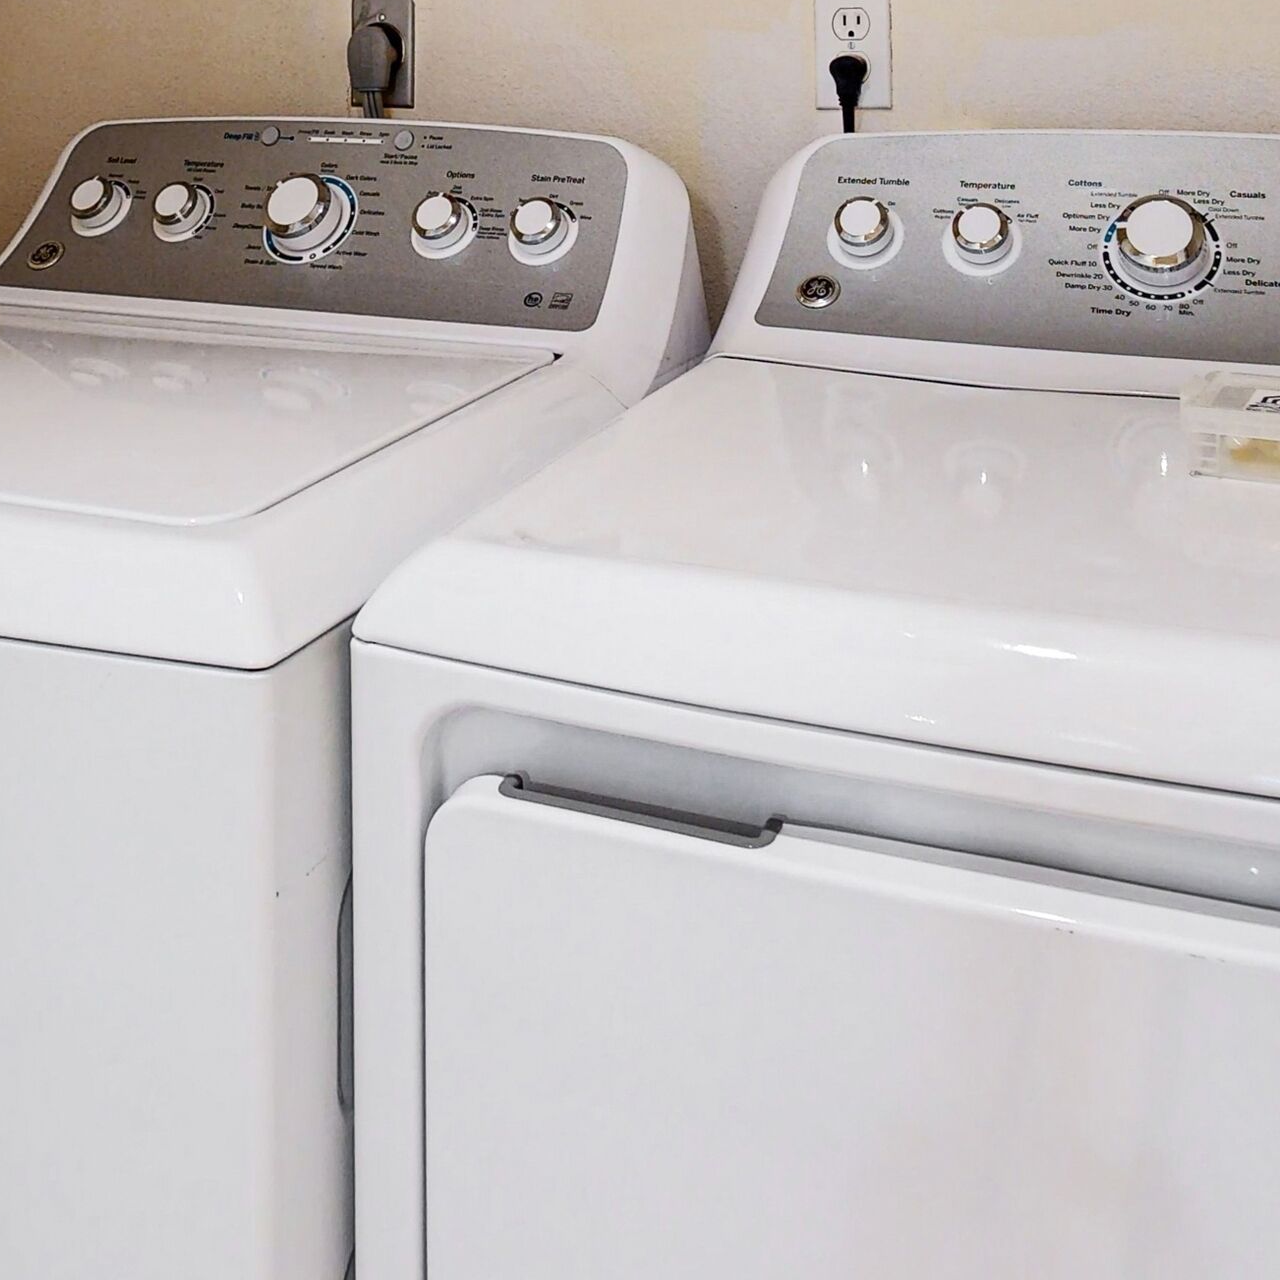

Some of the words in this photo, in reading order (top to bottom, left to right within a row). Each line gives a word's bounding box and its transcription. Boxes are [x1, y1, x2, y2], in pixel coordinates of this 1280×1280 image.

[224, 132, 241, 141] Deep
[184, 160, 224, 168] Temperature
[446, 170, 475, 180] Options
[531, 174, 551, 182] Stain
[837, 176, 877, 185] Extended
[879, 177, 910, 186] Tumble
[960, 180, 1016, 190] Temperature
[1068, 179, 1103, 187] Cottons
[1230, 190, 1266, 199] Casuals
[1062, 212, 1096, 220] Optimum
[1247, 257, 1261, 265] Dry
[1056, 271, 1092, 279] Dewrinkle
[1090, 307, 1113, 315] Time
[1115, 308, 1131, 317] Dry
